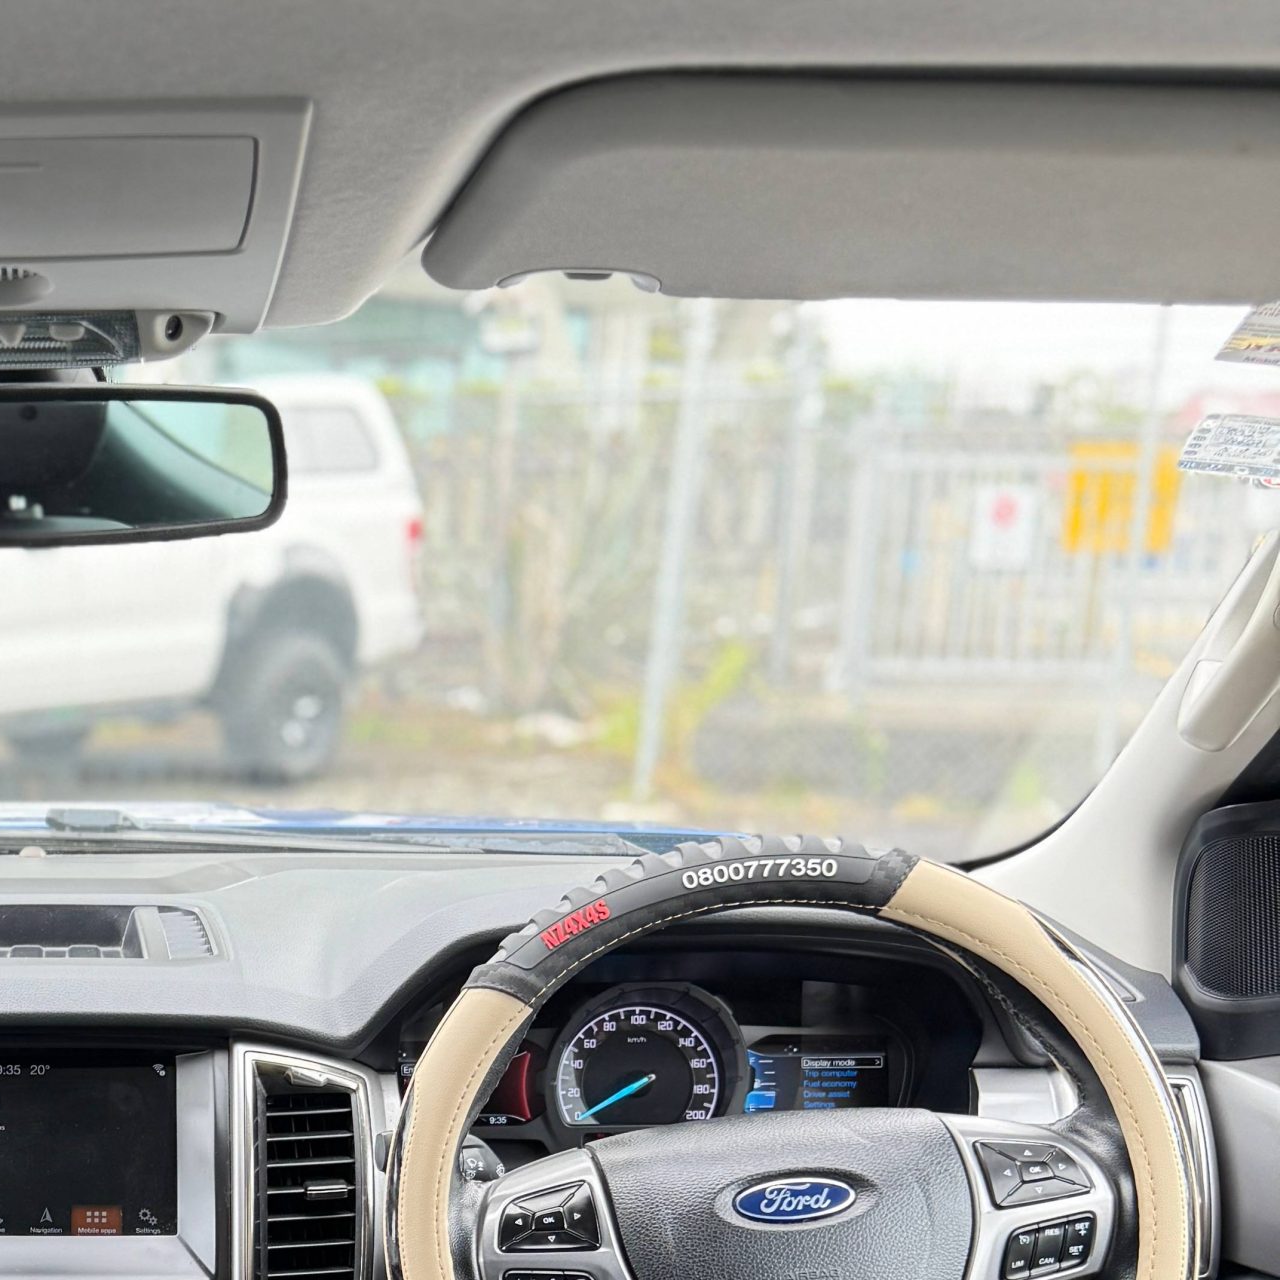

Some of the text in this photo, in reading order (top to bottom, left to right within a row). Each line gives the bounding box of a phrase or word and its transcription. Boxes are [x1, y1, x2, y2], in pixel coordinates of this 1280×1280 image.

[682, 858, 838, 889] 0800777350
[540, 899, 611, 950] NZ4X4S
[631, 1015, 646, 1024] 100
[603, 1022, 616, 1031] 80
[658, 1021, 673, 1030] 120
[584, 1039, 596, 1048] 60
[678, 1038, 695, 1047] 140
[571, 1060, 583, 1069] 40
[690, 1059, 707, 1068] 160
[568, 1088, 580, 1097] 20
[693, 1085, 710, 1094] 180
[804, 1101, 835, 1109] Settings
[686, 1110, 706, 1120] 200
[760, 1183, 831, 1213] Ford
[1075, 1222, 1090, 1230] SET
[1045, 1228, 1060, 1236] RES
[1069, 1245, 1084, 1253] SET
[1011, 1260, 1024, 1268] LIM
[1039, 1257, 1054, 1265] CAN
